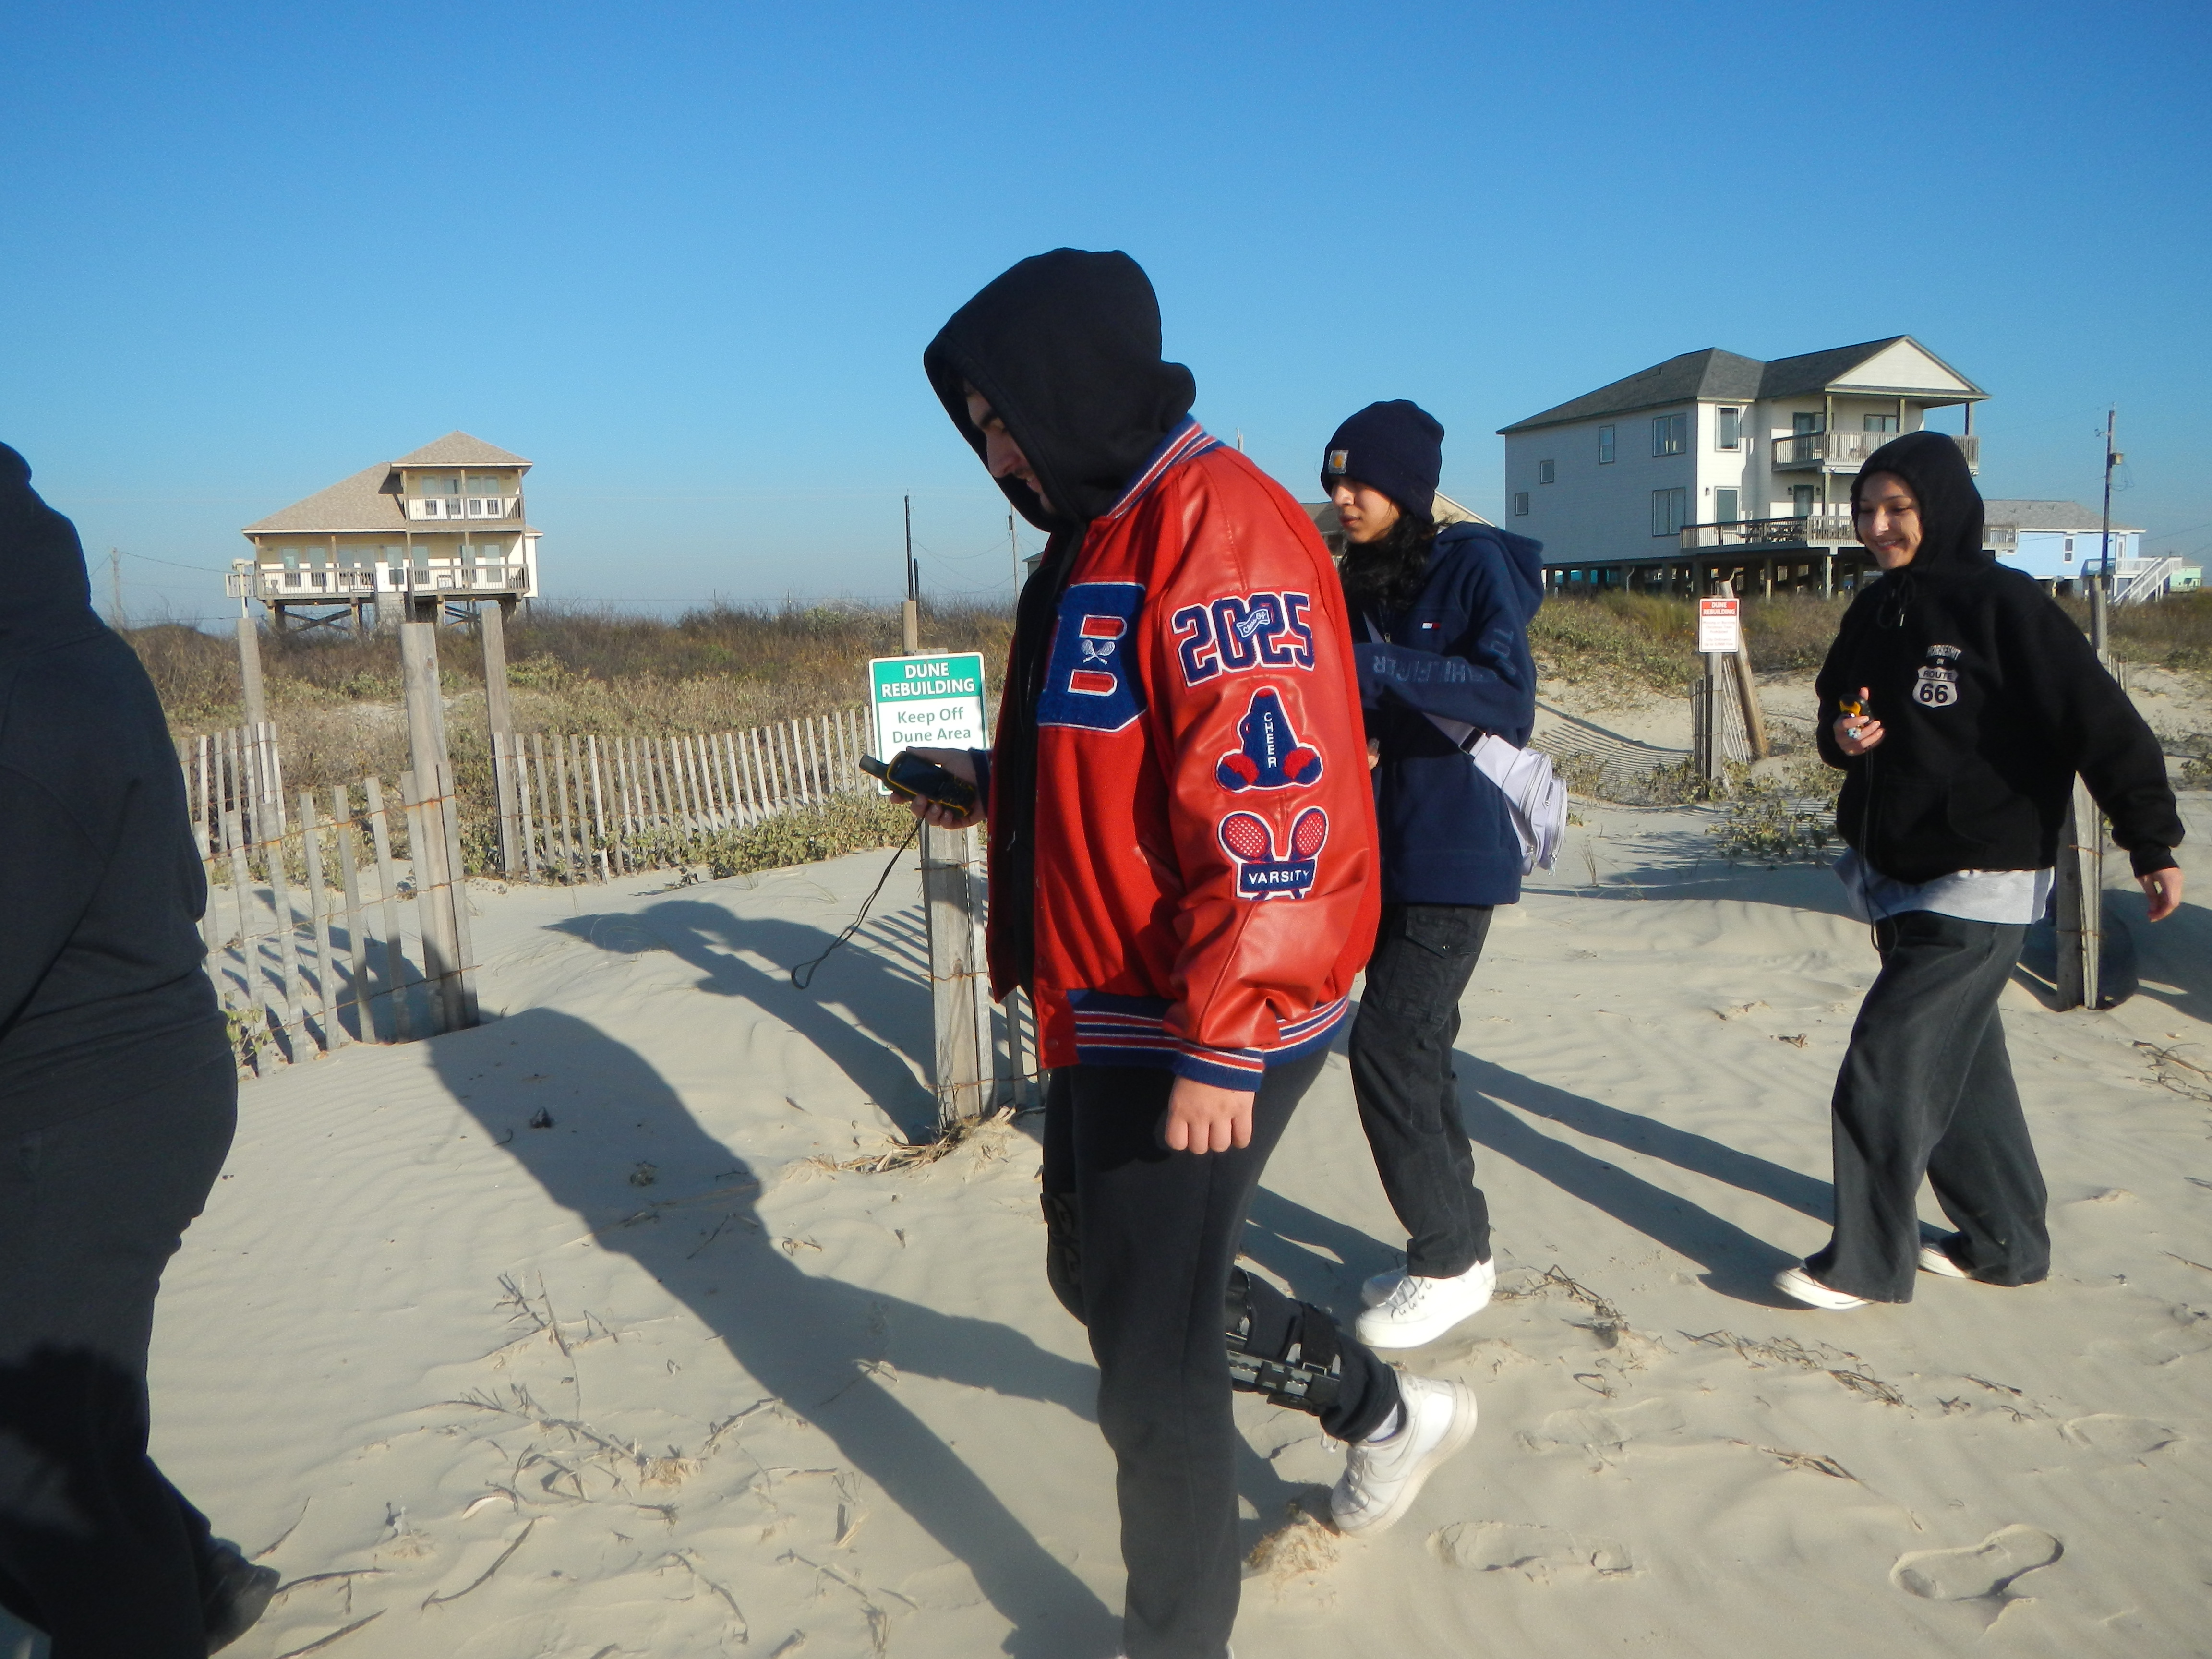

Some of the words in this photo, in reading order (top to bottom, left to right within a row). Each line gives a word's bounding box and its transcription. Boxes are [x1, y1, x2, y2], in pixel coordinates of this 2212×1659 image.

[1171, 590, 1316, 688] 2025
[905, 662, 950, 679] DUNE
[1923, 670, 1953, 680] ROUTE
[881, 678, 975, 698] REBUILDING
[1920, 683, 1948, 703] 66
[897, 711, 935, 726] Keep
[939, 706, 964, 721] Off
[892, 731, 932, 744] Dune
[937, 728, 971, 740] Area
[1263, 712, 1277, 768] CHEER
[1248, 869, 1310, 885] VARSITY
